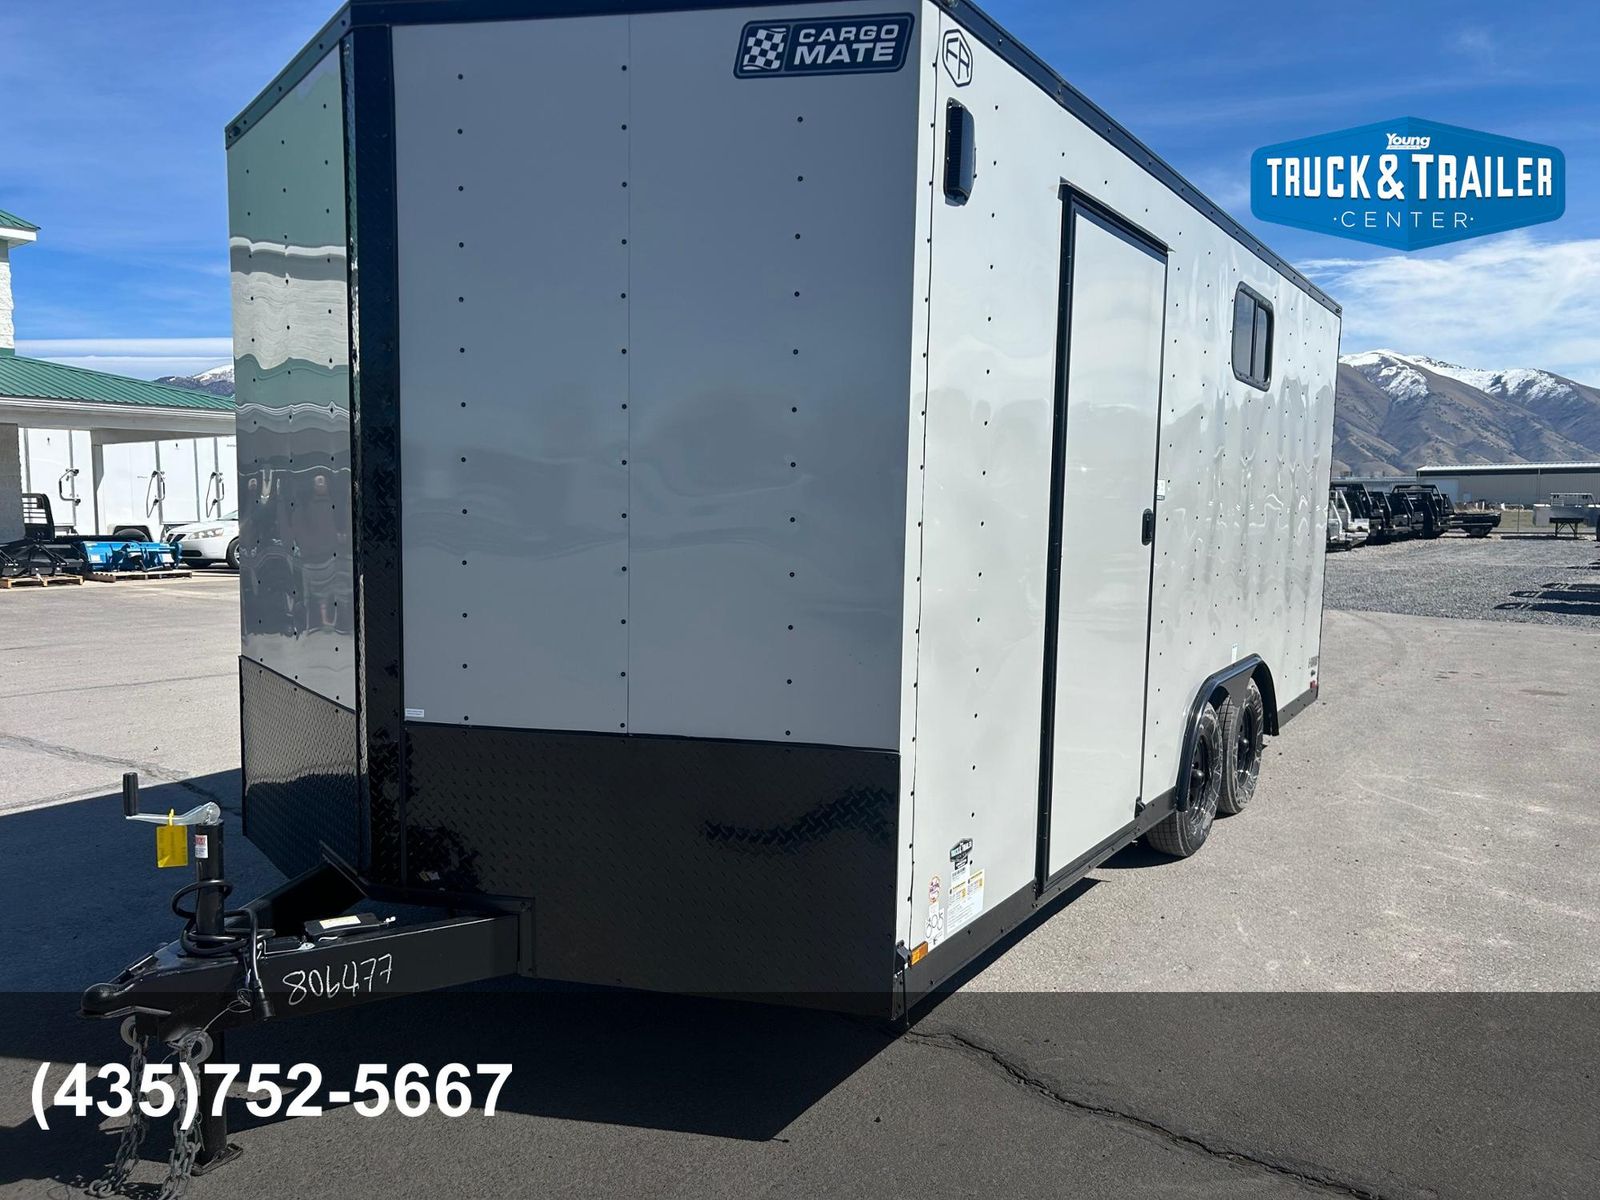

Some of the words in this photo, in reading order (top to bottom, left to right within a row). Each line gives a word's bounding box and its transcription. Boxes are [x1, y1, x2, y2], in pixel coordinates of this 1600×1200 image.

[798, 24, 899, 43] CARGO
[793, 42, 896, 65] MATE
[282, 953, 392, 1005] 806477
